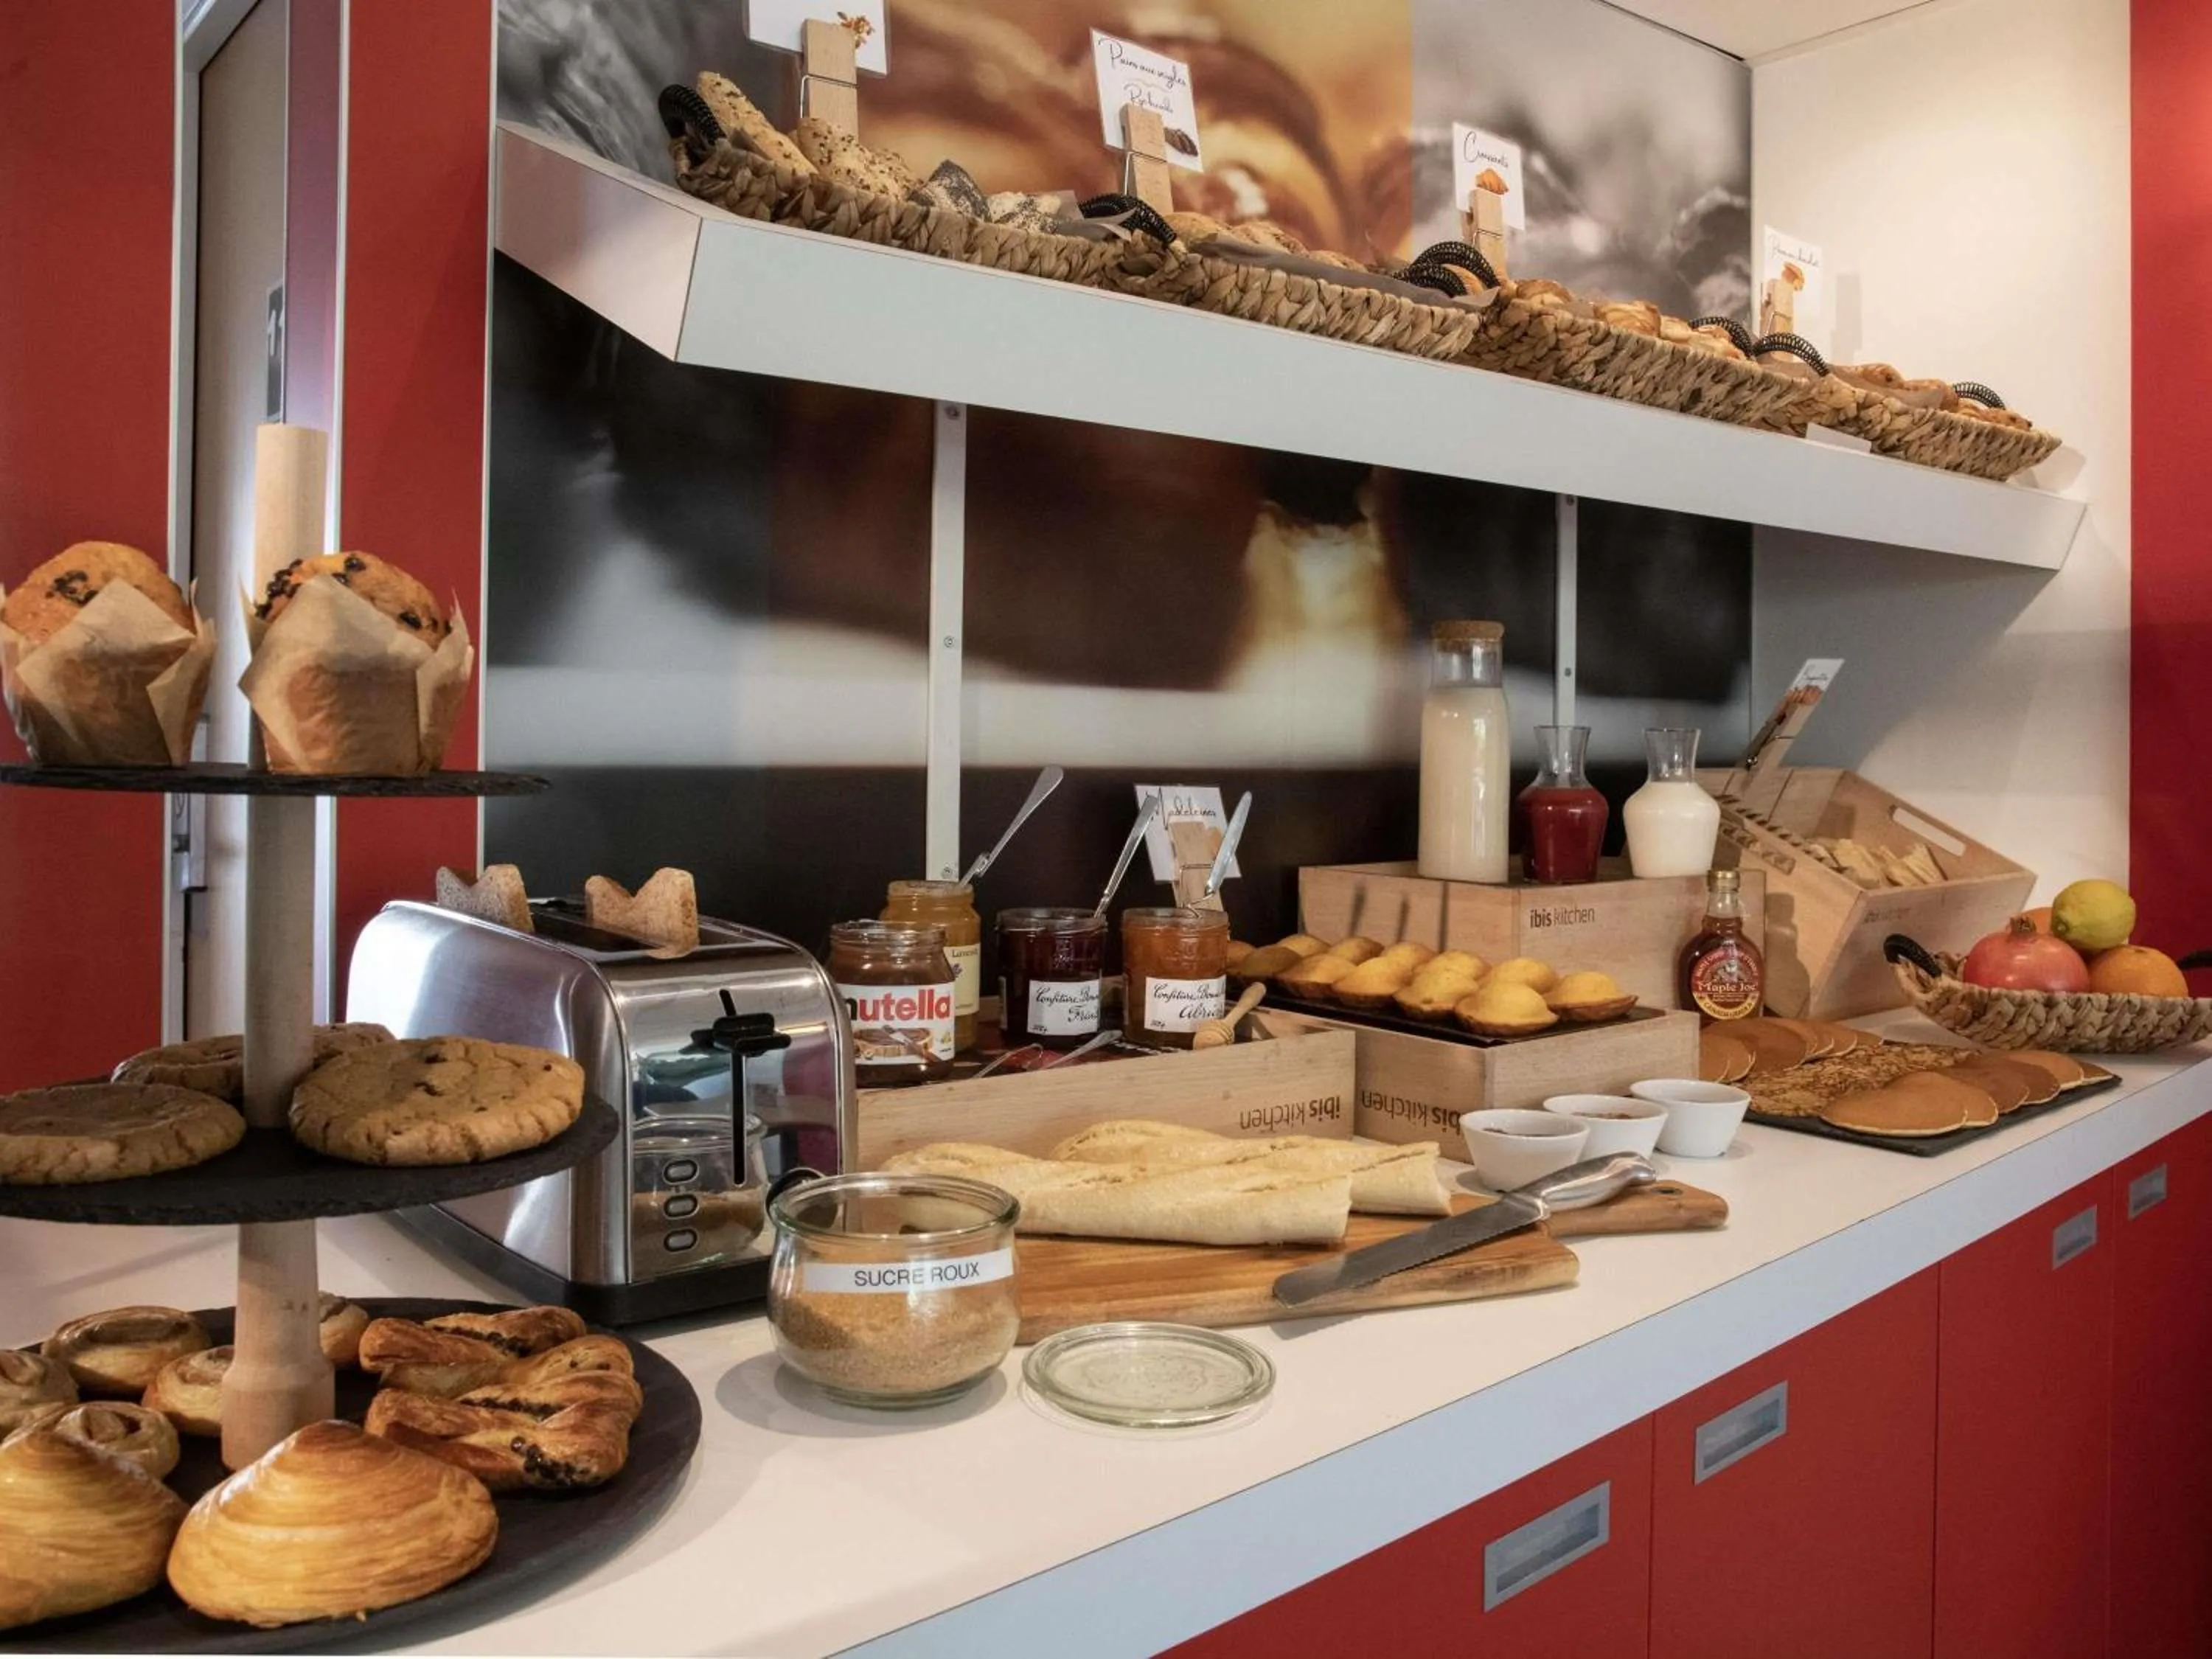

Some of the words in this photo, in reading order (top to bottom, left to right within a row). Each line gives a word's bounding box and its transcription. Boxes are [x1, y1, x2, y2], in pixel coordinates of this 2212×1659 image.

[1530, 908, 1552, 928] ibis
[1554, 906, 1595, 926] kitchen
[1698, 981, 1736, 993] Maple
[1239, 1103, 1305, 1130] kitchen
[1309, 1096, 1340, 1121] ibis
[1362, 1090, 1427, 1127] kitchen
[1431, 1107, 1463, 1135] bis
[854, 1268, 923, 1287] SUCRE
[931, 1262, 980, 1281] ROUX
